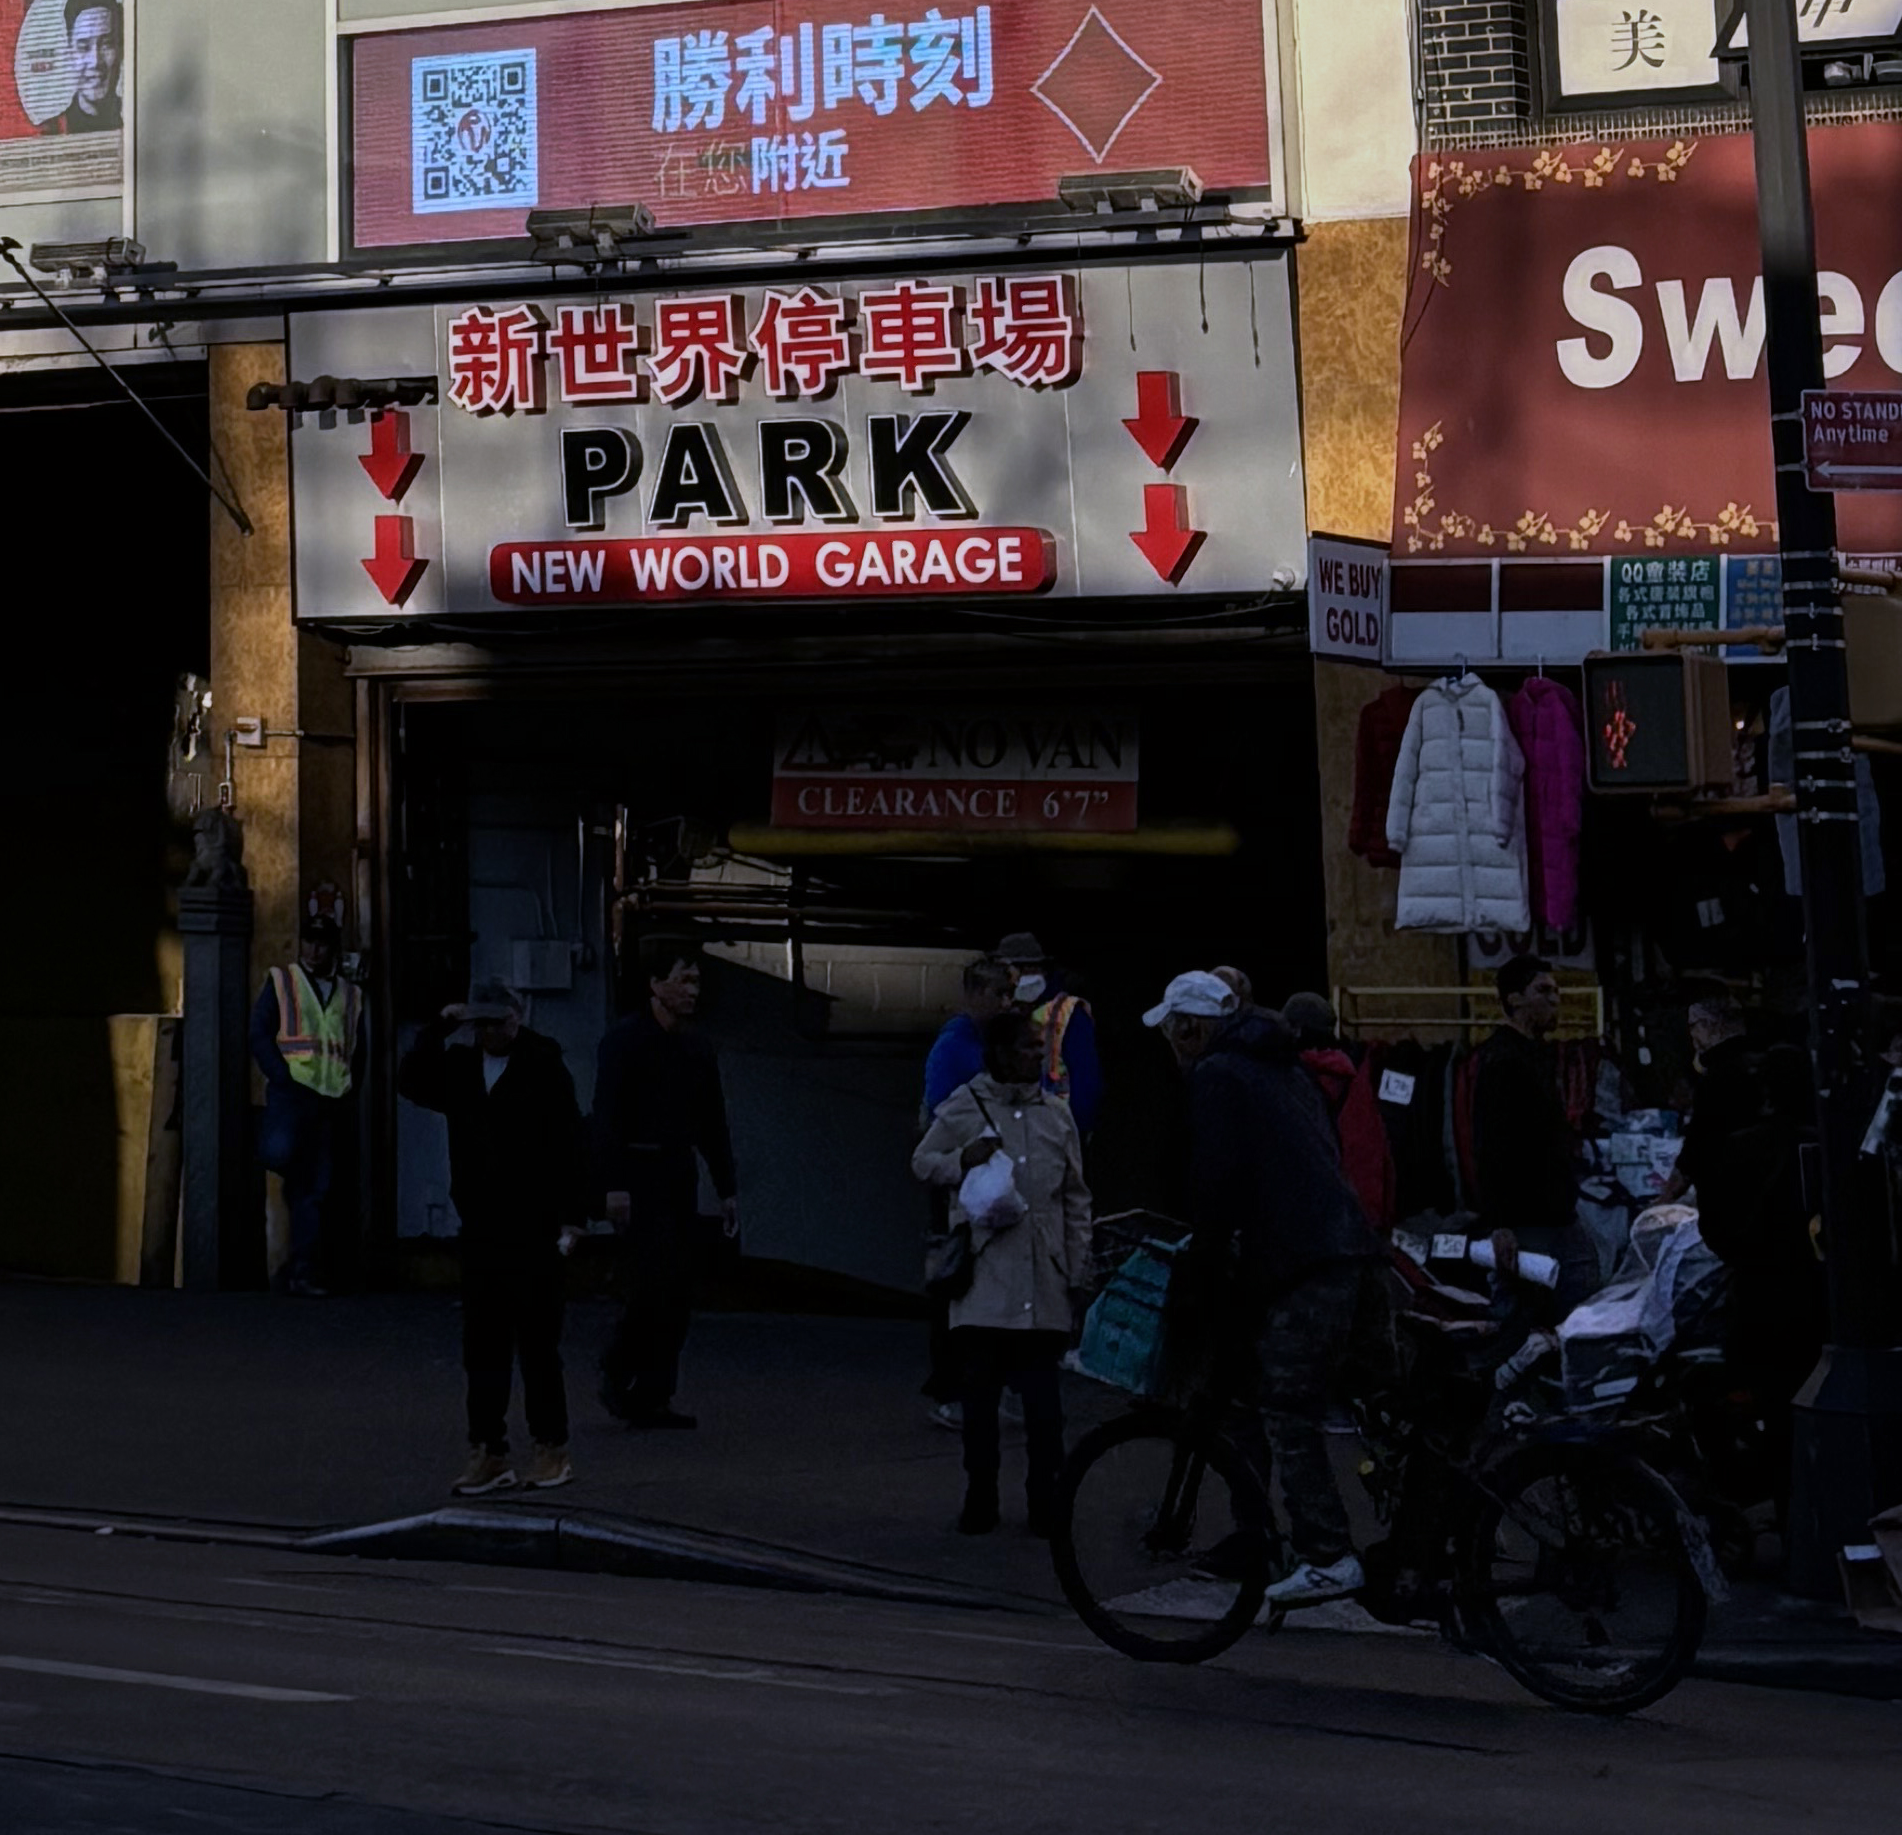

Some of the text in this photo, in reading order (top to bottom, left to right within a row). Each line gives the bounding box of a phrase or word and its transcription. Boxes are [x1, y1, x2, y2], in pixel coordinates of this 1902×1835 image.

[1609, 8, 1667, 73] 美
[652, 4, 994, 134] 勝利時刻
[447, 272, 1083, 417] 新世界停車場
[1810, 400, 1836, 421] NO
[1813, 423, 1889, 447] Anytime
[559, 409, 972, 530] PARK
[510, 535, 1024, 596] NEW WORLD GARAGE
[1319, 557, 1381, 599] WE BUY
[1326, 606, 1379, 647] GOLD
[927, 718, 1124, 770] NO VAN
[797, 786, 1017, 819] CLEARANCE
